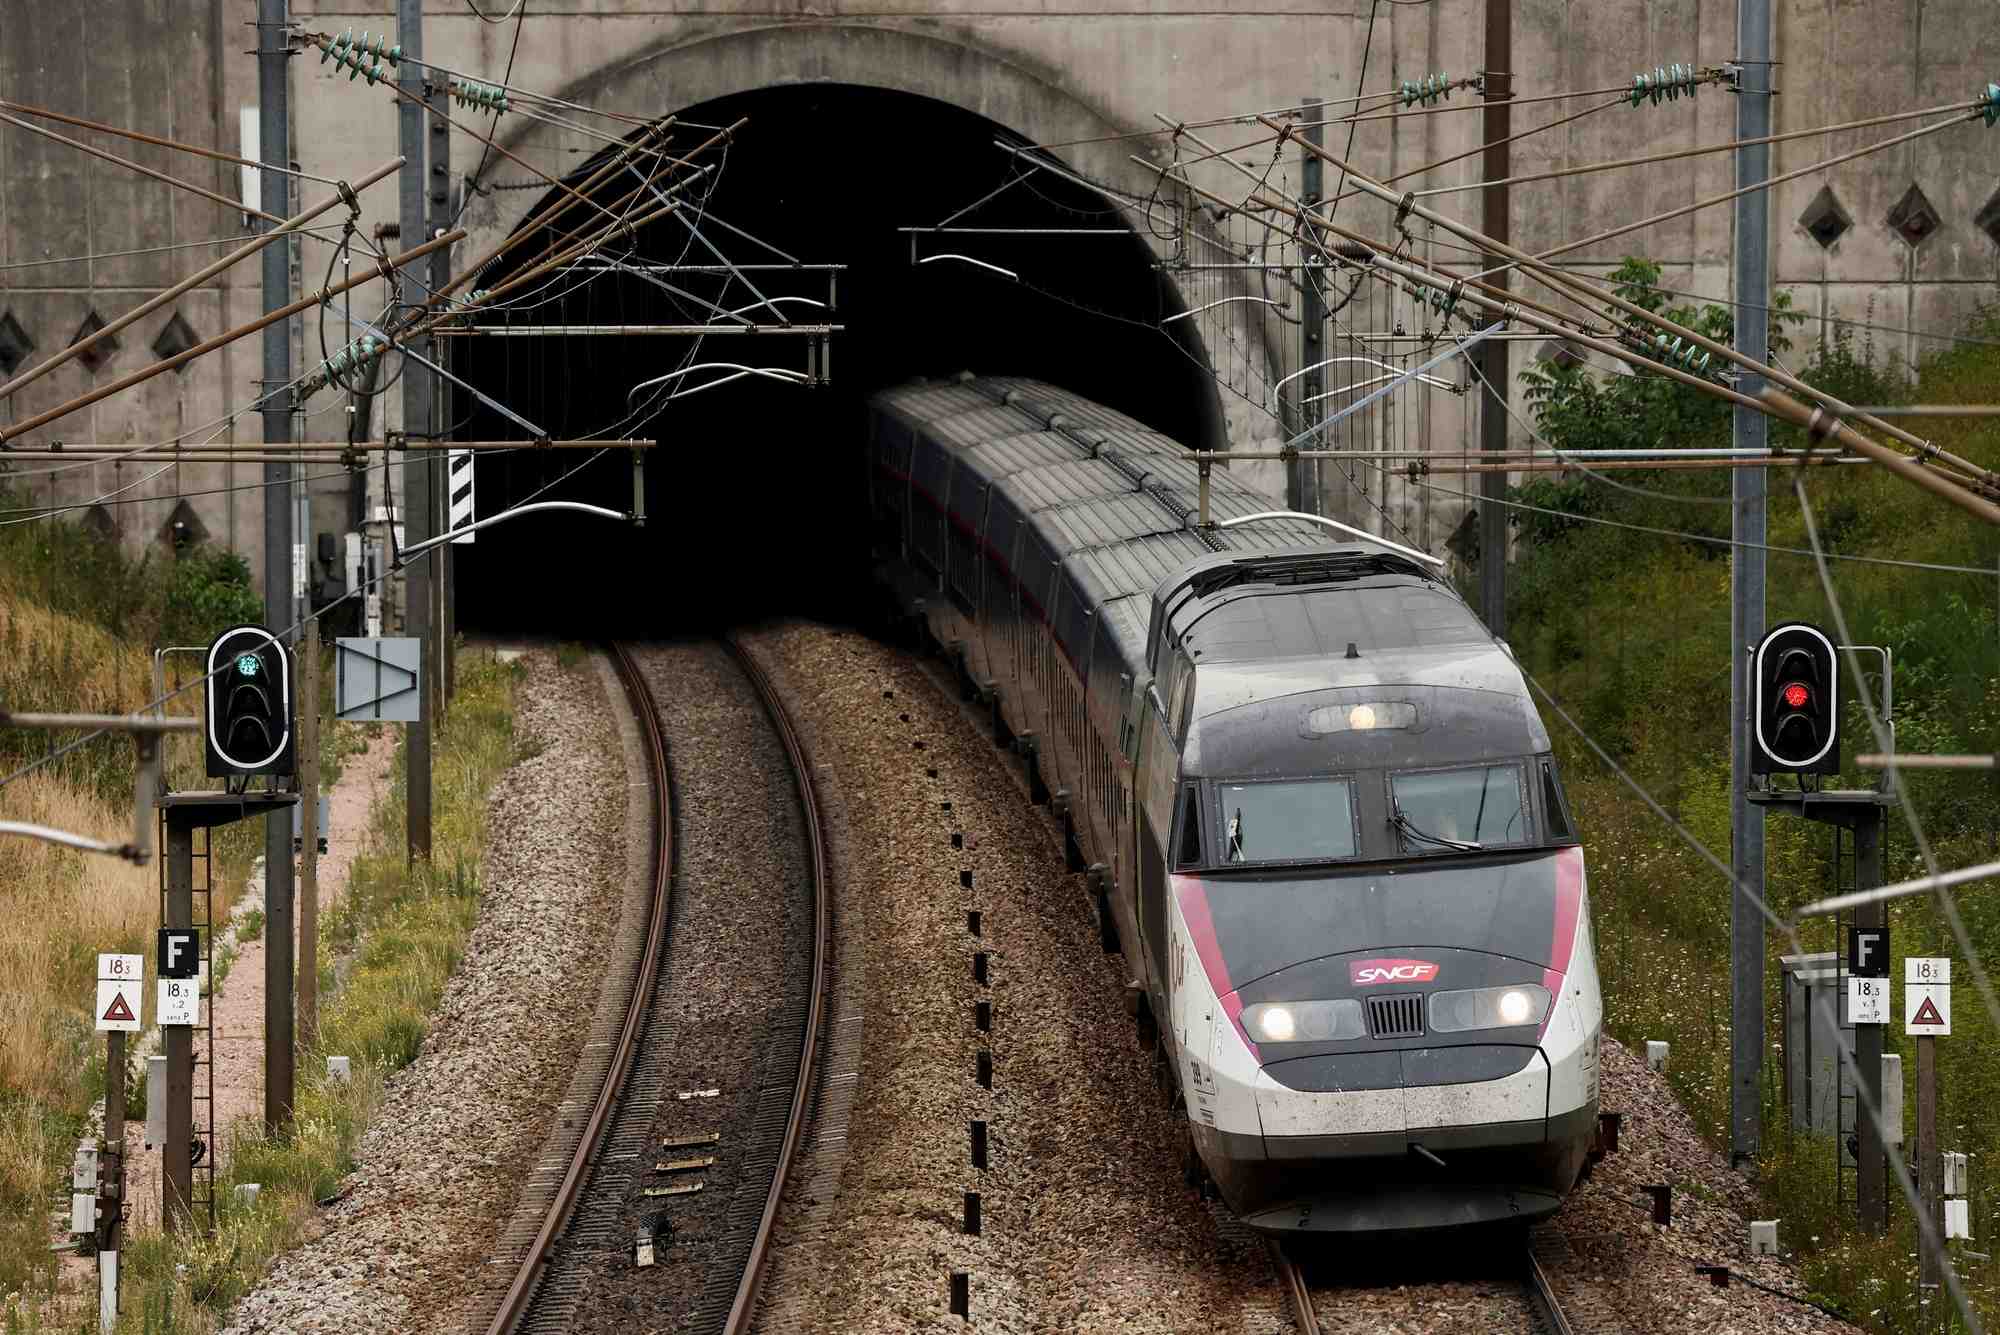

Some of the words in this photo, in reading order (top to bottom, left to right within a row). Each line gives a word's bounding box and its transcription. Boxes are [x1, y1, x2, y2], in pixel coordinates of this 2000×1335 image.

[168, 935, 190, 969] F
[1858, 933, 1880, 967] F
[1355, 965, 1433, 983] SNCF
